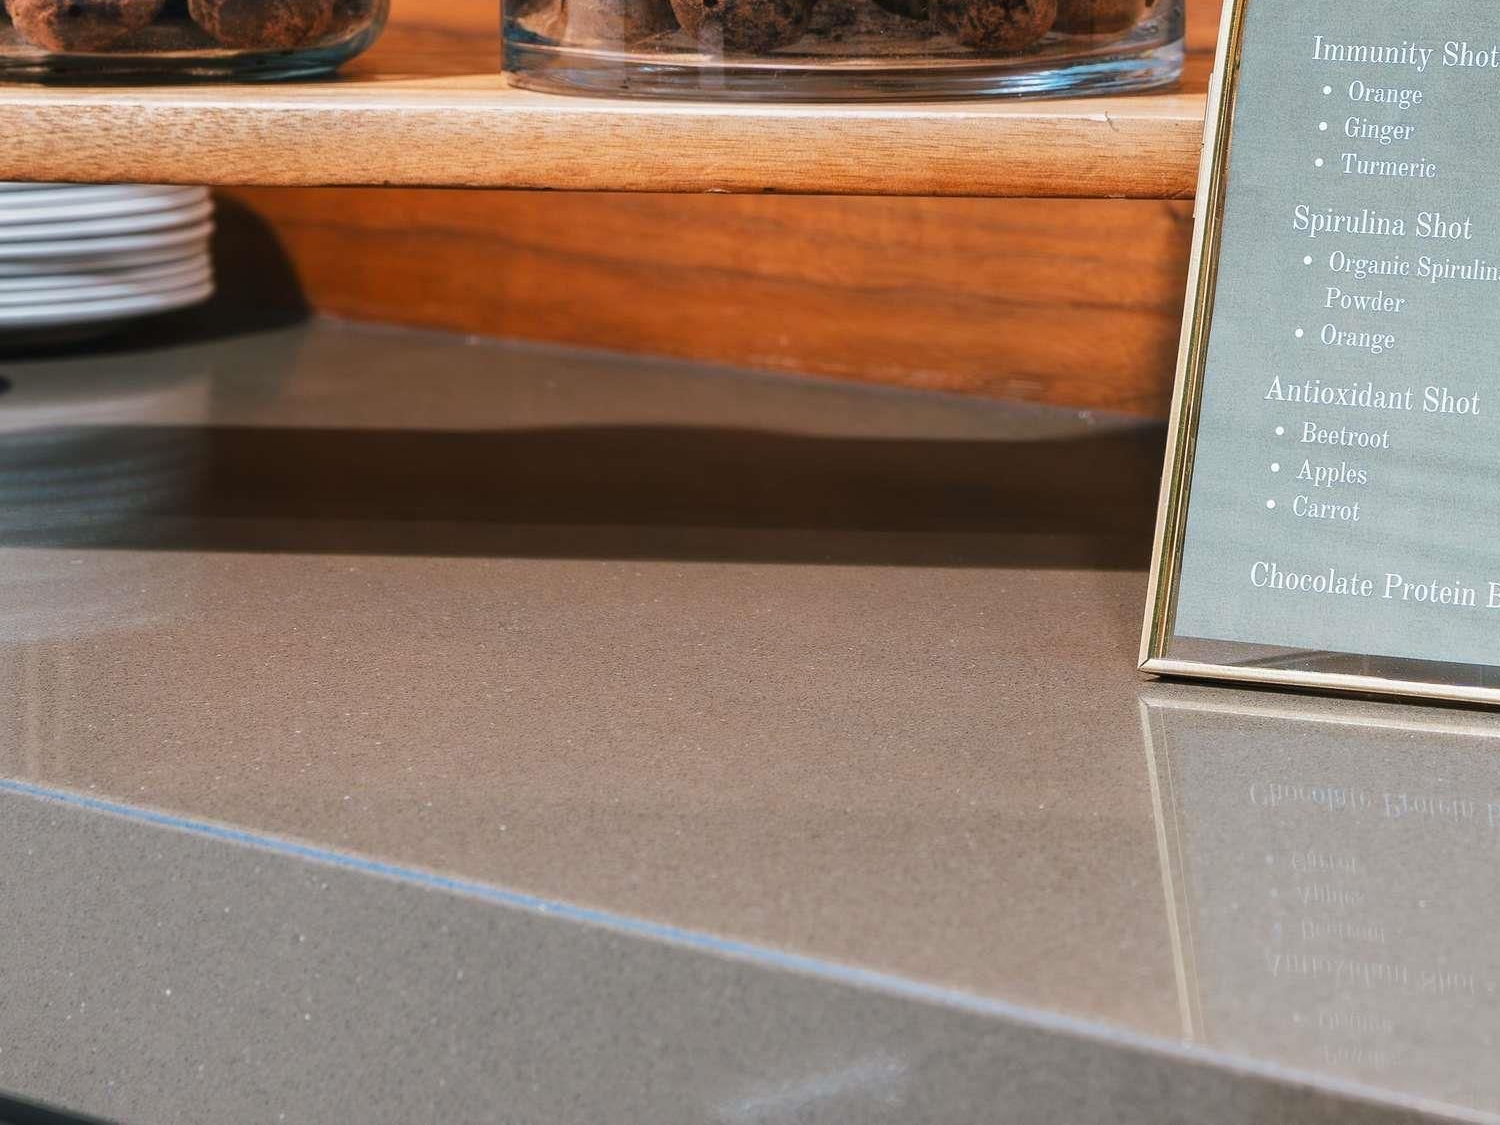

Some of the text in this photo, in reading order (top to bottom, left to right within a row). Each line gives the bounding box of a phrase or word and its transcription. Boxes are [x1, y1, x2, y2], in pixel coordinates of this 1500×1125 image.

[1312, 35, 1499, 72] Immunity Shot
[1348, 80, 1423, 110] Orange
[1344, 116, 1415, 145] Ginger
[1341, 152, 1436, 178] Turmeric
[1292, 204, 1472, 240] Spirulina Shot
[1329, 250, 1411, 278] Organic
[1325, 287, 1405, 312] Powder
[1320, 323, 1395, 353] Orange
[1264, 375, 1480, 415] Antioxidant Shot
[1301, 421, 1389, 449] Beetroot
[1296, 459, 1367, 488] Apples
[1292, 495, 1359, 522] Carrot
[1250, 561, 1373, 596] Chocolate
[1382, 573, 1476, 606] Protein
